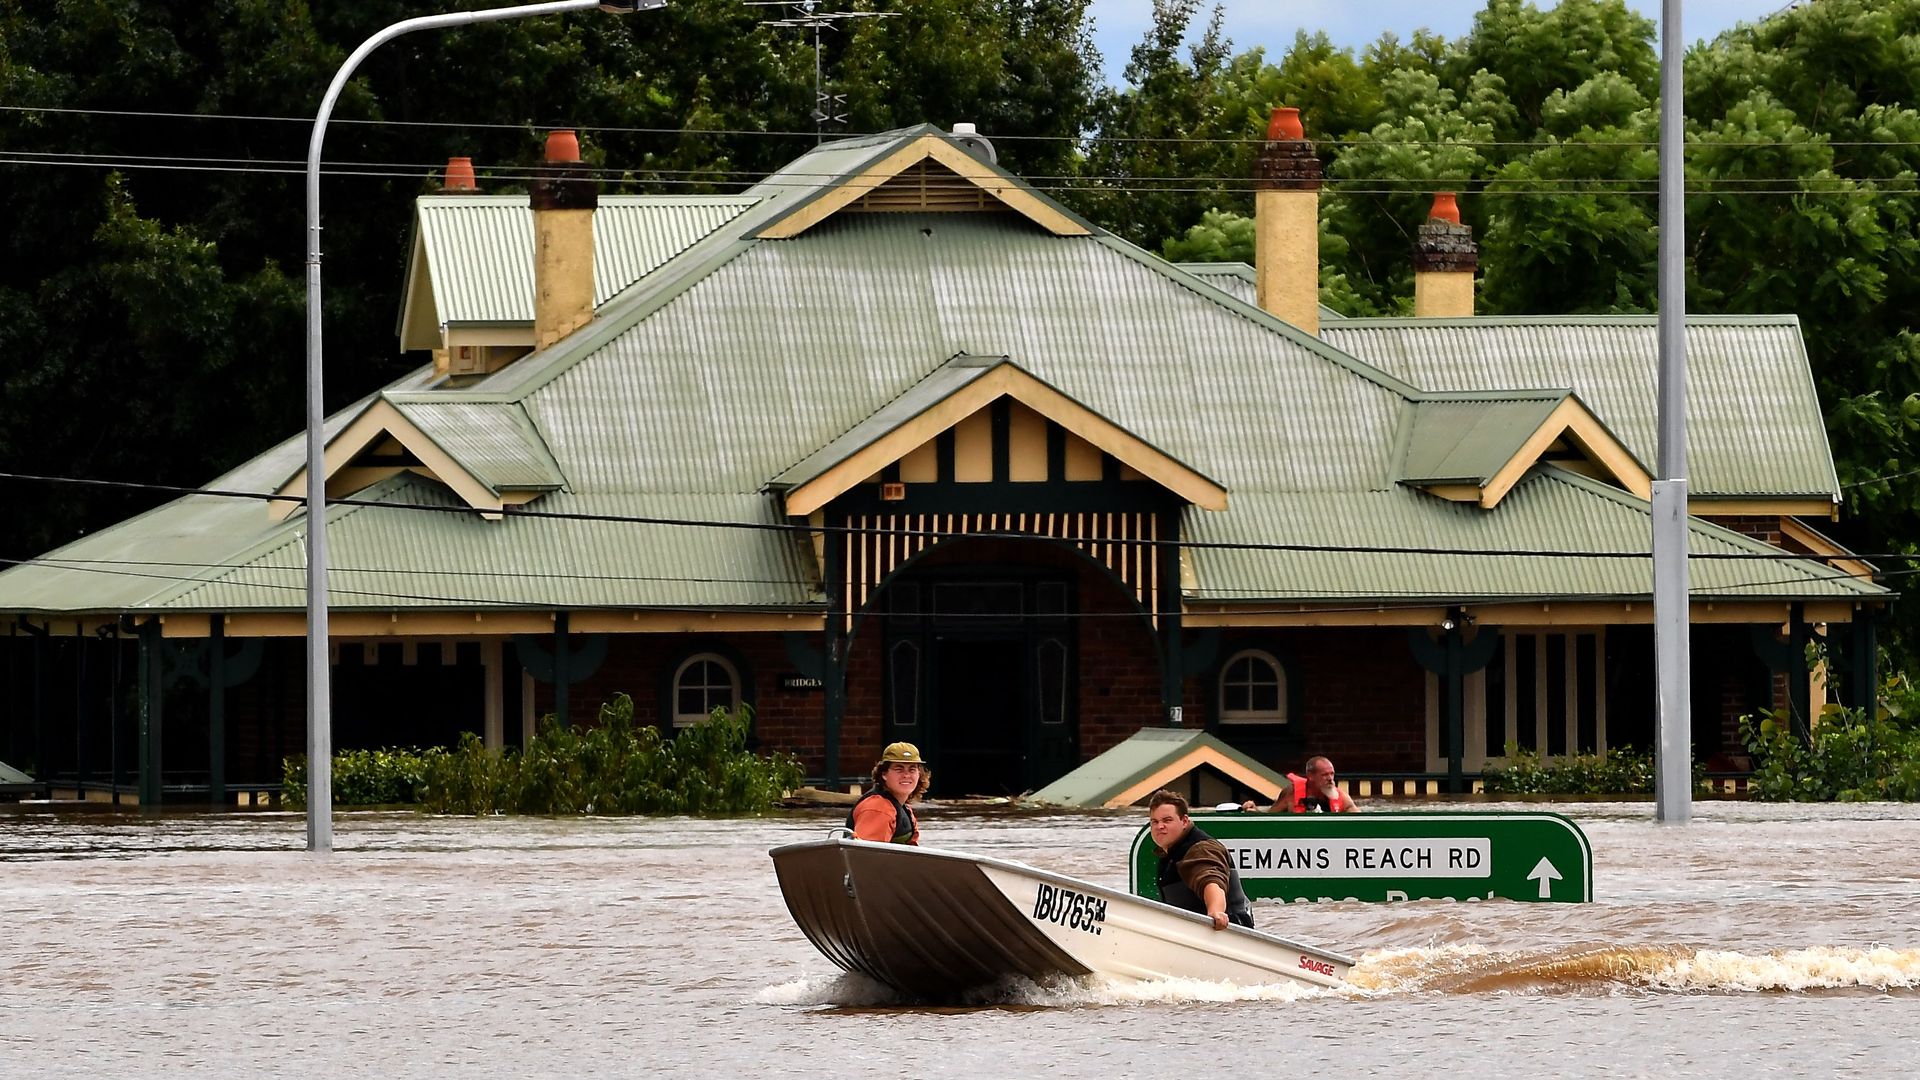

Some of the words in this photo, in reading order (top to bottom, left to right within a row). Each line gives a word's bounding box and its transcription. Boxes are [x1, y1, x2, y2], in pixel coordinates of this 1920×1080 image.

[1345, 848, 1432, 869] REACH
[1449, 848, 1481, 869] RD
[1298, 955, 1335, 976] SAVAGE
